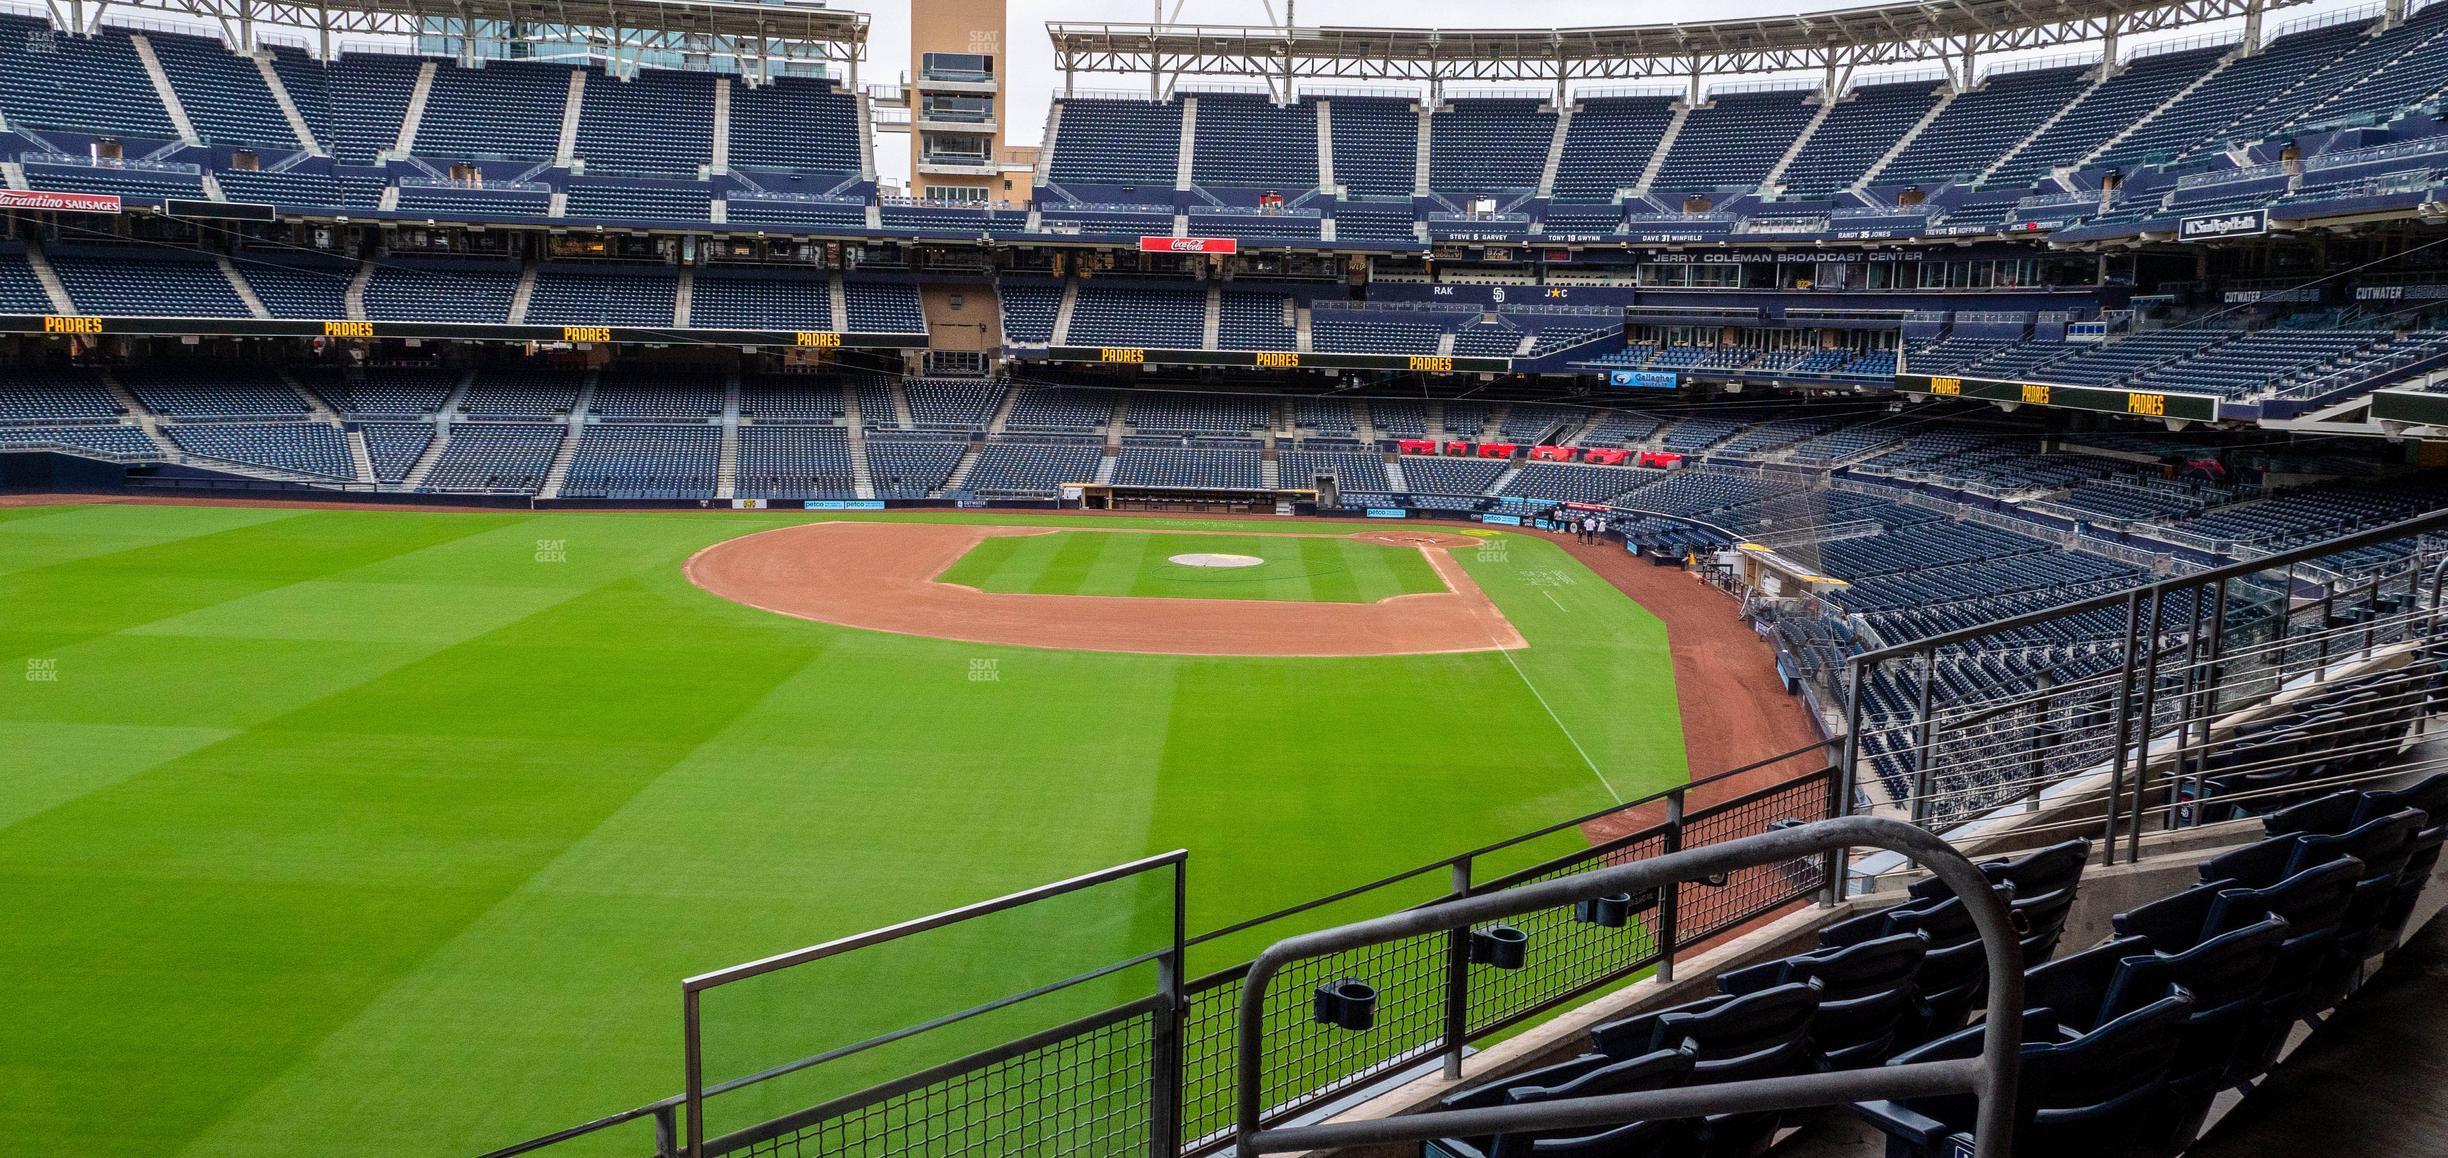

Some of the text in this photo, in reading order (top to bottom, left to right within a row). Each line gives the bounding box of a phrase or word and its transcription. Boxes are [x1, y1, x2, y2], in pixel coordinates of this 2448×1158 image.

[65, 200, 119, 211] SAUSAGES
[1860, 231, 1869, 239] 35
[1653, 251, 1923, 262] JERRY COLEMAN BROADCAST CENTER
[1434, 287, 1453, 295] RAK
[2224, 291, 2260, 303] CUTWATER
[2356, 286, 2403, 300] CUTWATER
[45, 316, 103, 333] PADRES
[325, 321, 373, 337] PADRES
[564, 327, 610, 342] PADRES
[797, 332, 841, 347] PADRES
[1102, 348, 1144, 362] PADRES
[1256, 352, 1299, 367] PADRES
[1409, 356, 1452, 371] PADRES
[1635, 373, 1674, 382] Gallagher
[1930, 377, 1961, 395] PADRES
[2022, 384, 2050, 404] PADRES
[2127, 392, 2165, 416] PADRES
[1483, 514, 1501, 522] petco
